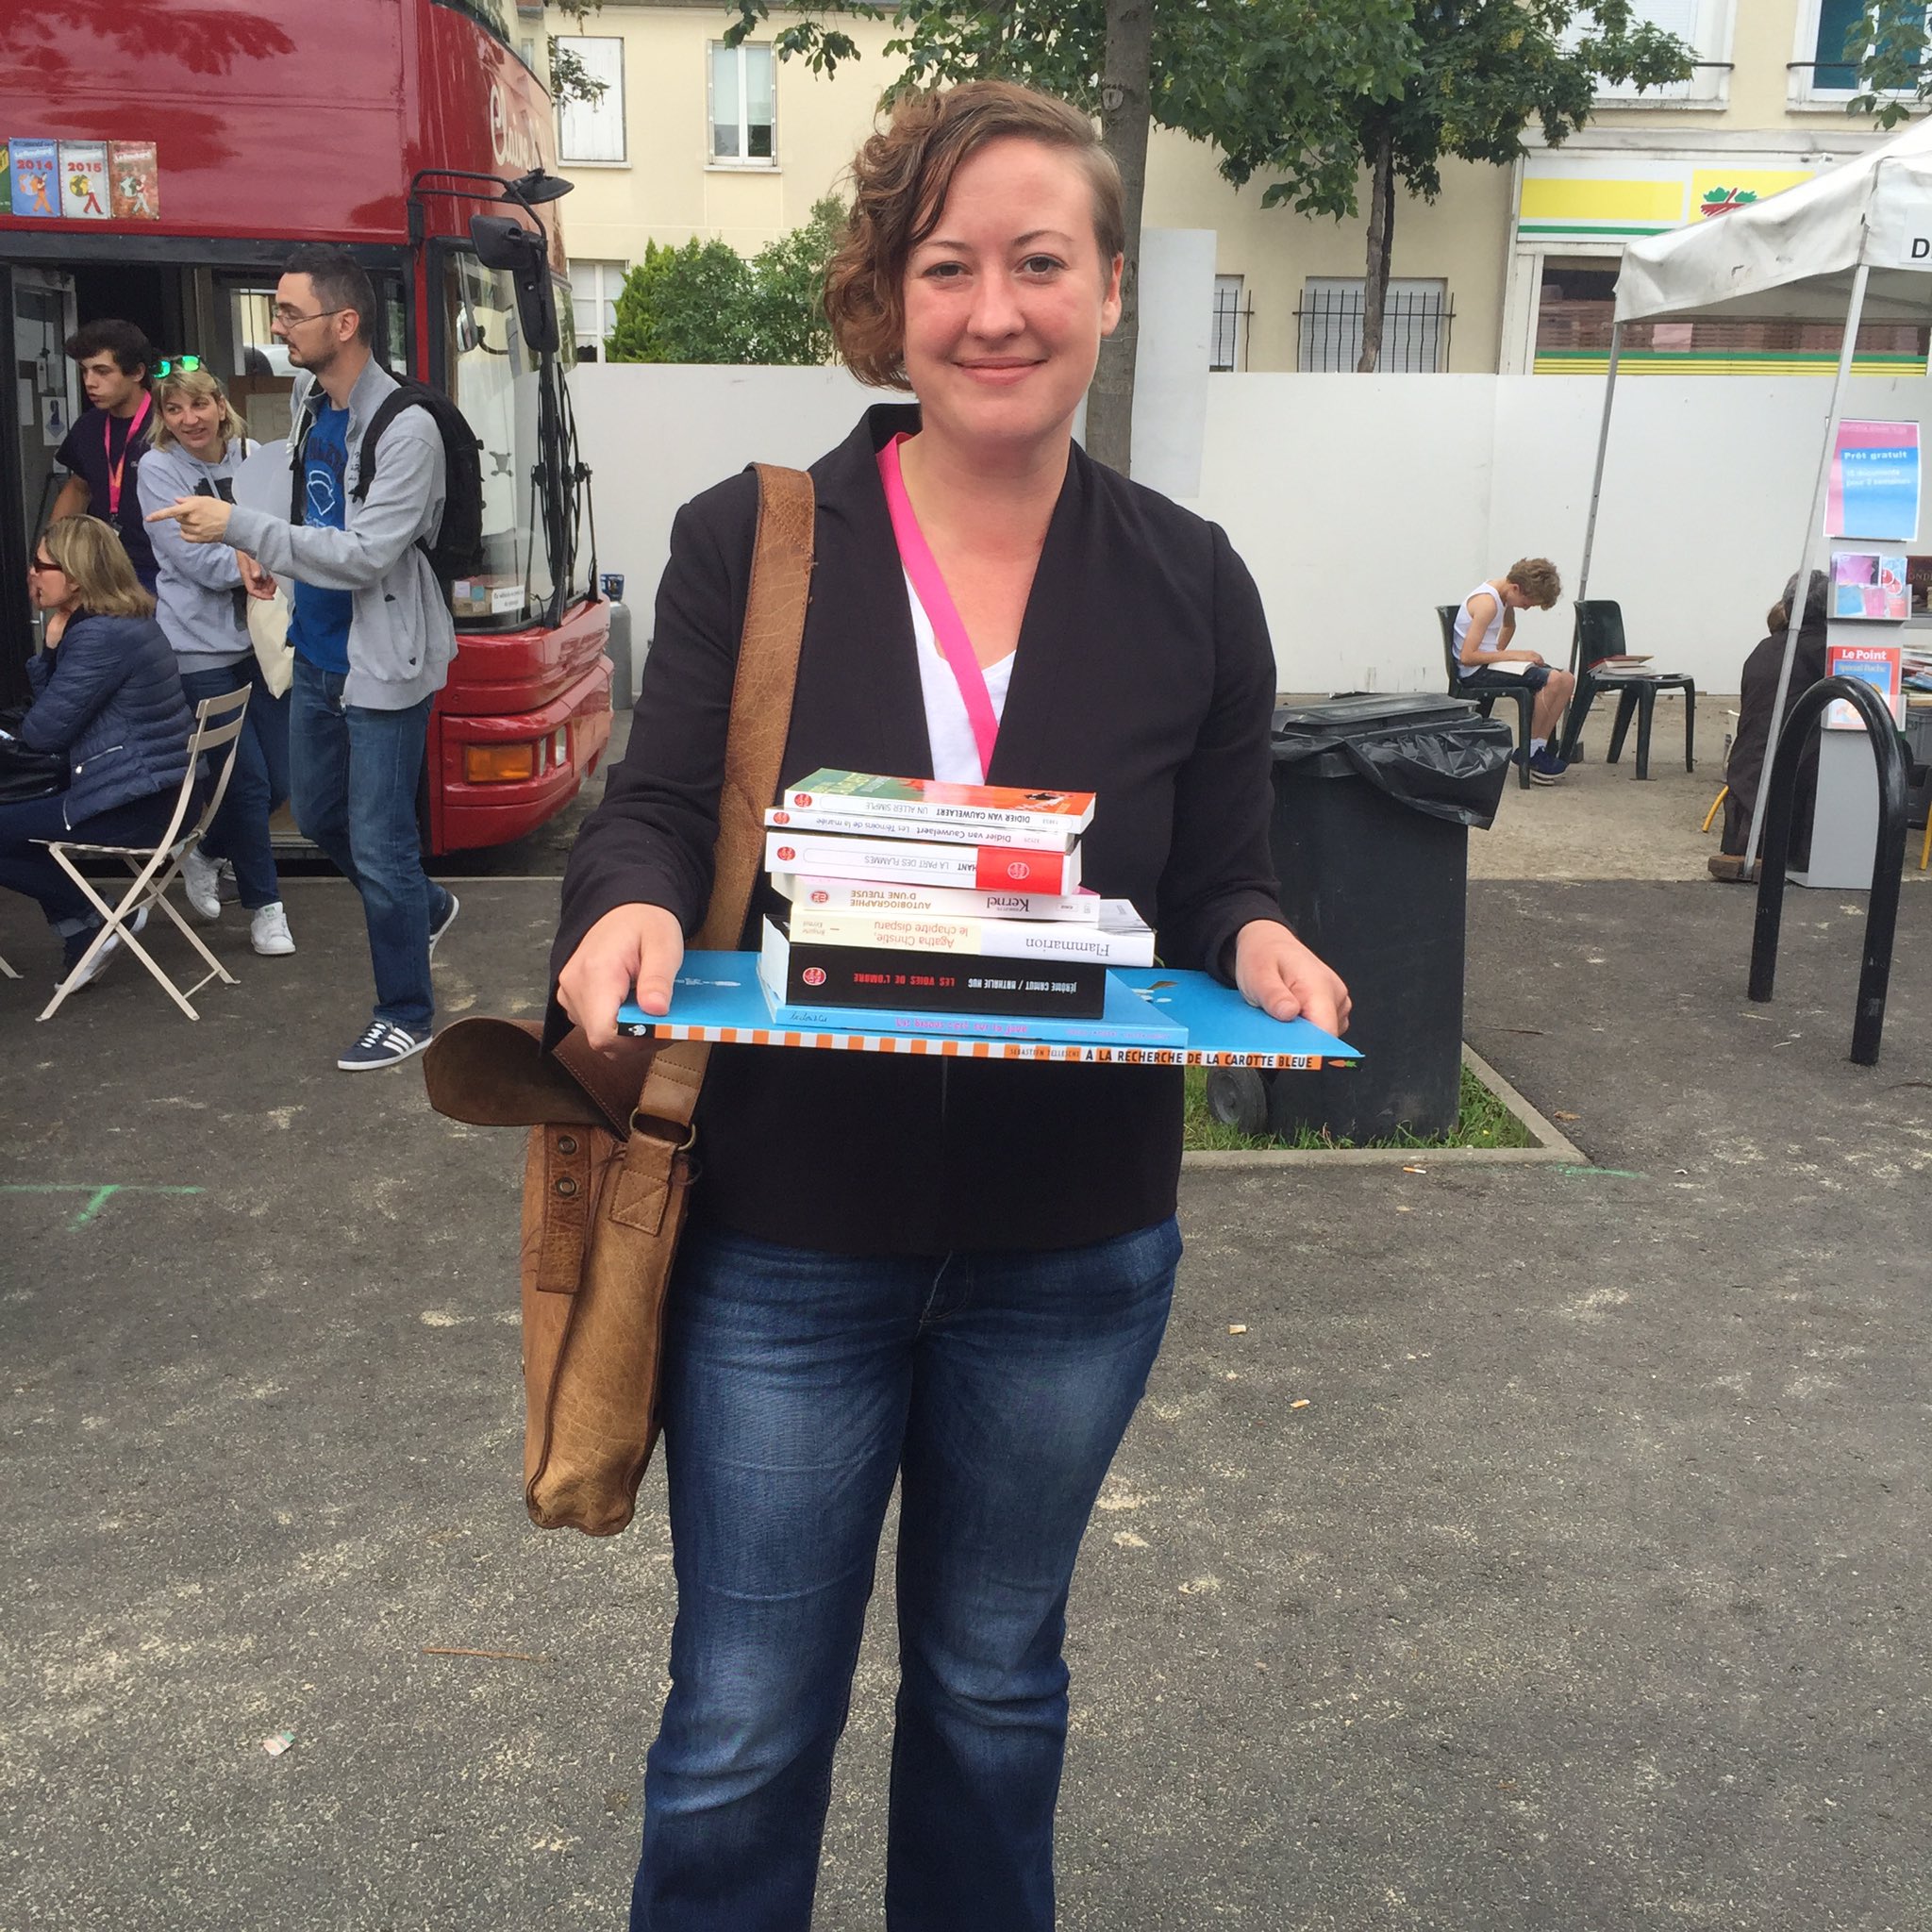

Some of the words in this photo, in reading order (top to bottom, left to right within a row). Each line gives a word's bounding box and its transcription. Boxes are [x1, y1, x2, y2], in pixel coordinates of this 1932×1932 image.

[16, 158, 54, 171] 2014
[67, 161, 103, 173] 2015
[1911, 238, 1932, 258] D
[1870, 450, 1907, 460] gratuit
[1841, 649, 1855, 659] Le
[1856, 649, 1888, 660] Point
[866, 802, 892, 811] SIMPLE
[893, 805, 915, 813] ALLER
[936, 808, 986, 820] CAUWELAERT
[1005, 814, 1030, 824] DIDIER
[816, 817, 842, 825] mariée
[916, 826, 965, 838] Cauwelaert
[986, 833, 1011, 842] Didier
[864, 855, 900, 866] FLAMMES
[901, 858, 917, 867] DES
[919, 859, 938, 869] PART
[939, 861, 949, 870] LA
[851, 890, 885, 898] TUEUSE
[888, 891, 916, 900] D'UNE
[850, 899, 931, 909] AUTOBIOGRAPHIE
[987, 896, 1030, 912] Kernel
[874, 921, 912, 932] disparu
[914, 924, 957, 935] chapitre
[959, 926, 969, 937] le
[874, 932, 915, 946] Christie,
[918, 935, 955, 948] Agatha
[1025, 938, 1110, 957] Flammarion
[853, 973, 891, 984] L'OMBRE
[894, 974, 906, 984] DE
[910, 975, 935, 986] VOIES
[940, 976, 955, 987] LES
[968, 978, 983, 989] HUG
[984, 978, 1016, 990] NATHALIE
[1024, 981, 1049, 991] CAMUT
[1051, 982, 1077, 994] JÉRÔME
[1099, 1050, 1112, 1061] LA
[1117, 1050, 1183, 1064] RECHERCHE
[1186, 1053, 1202, 1065] DE
[1206, 1054, 1219, 1065] LA
[1224, 1054, 1274, 1067] CAROTTE
[1277, 1055, 1313, 1068] BLEUE
